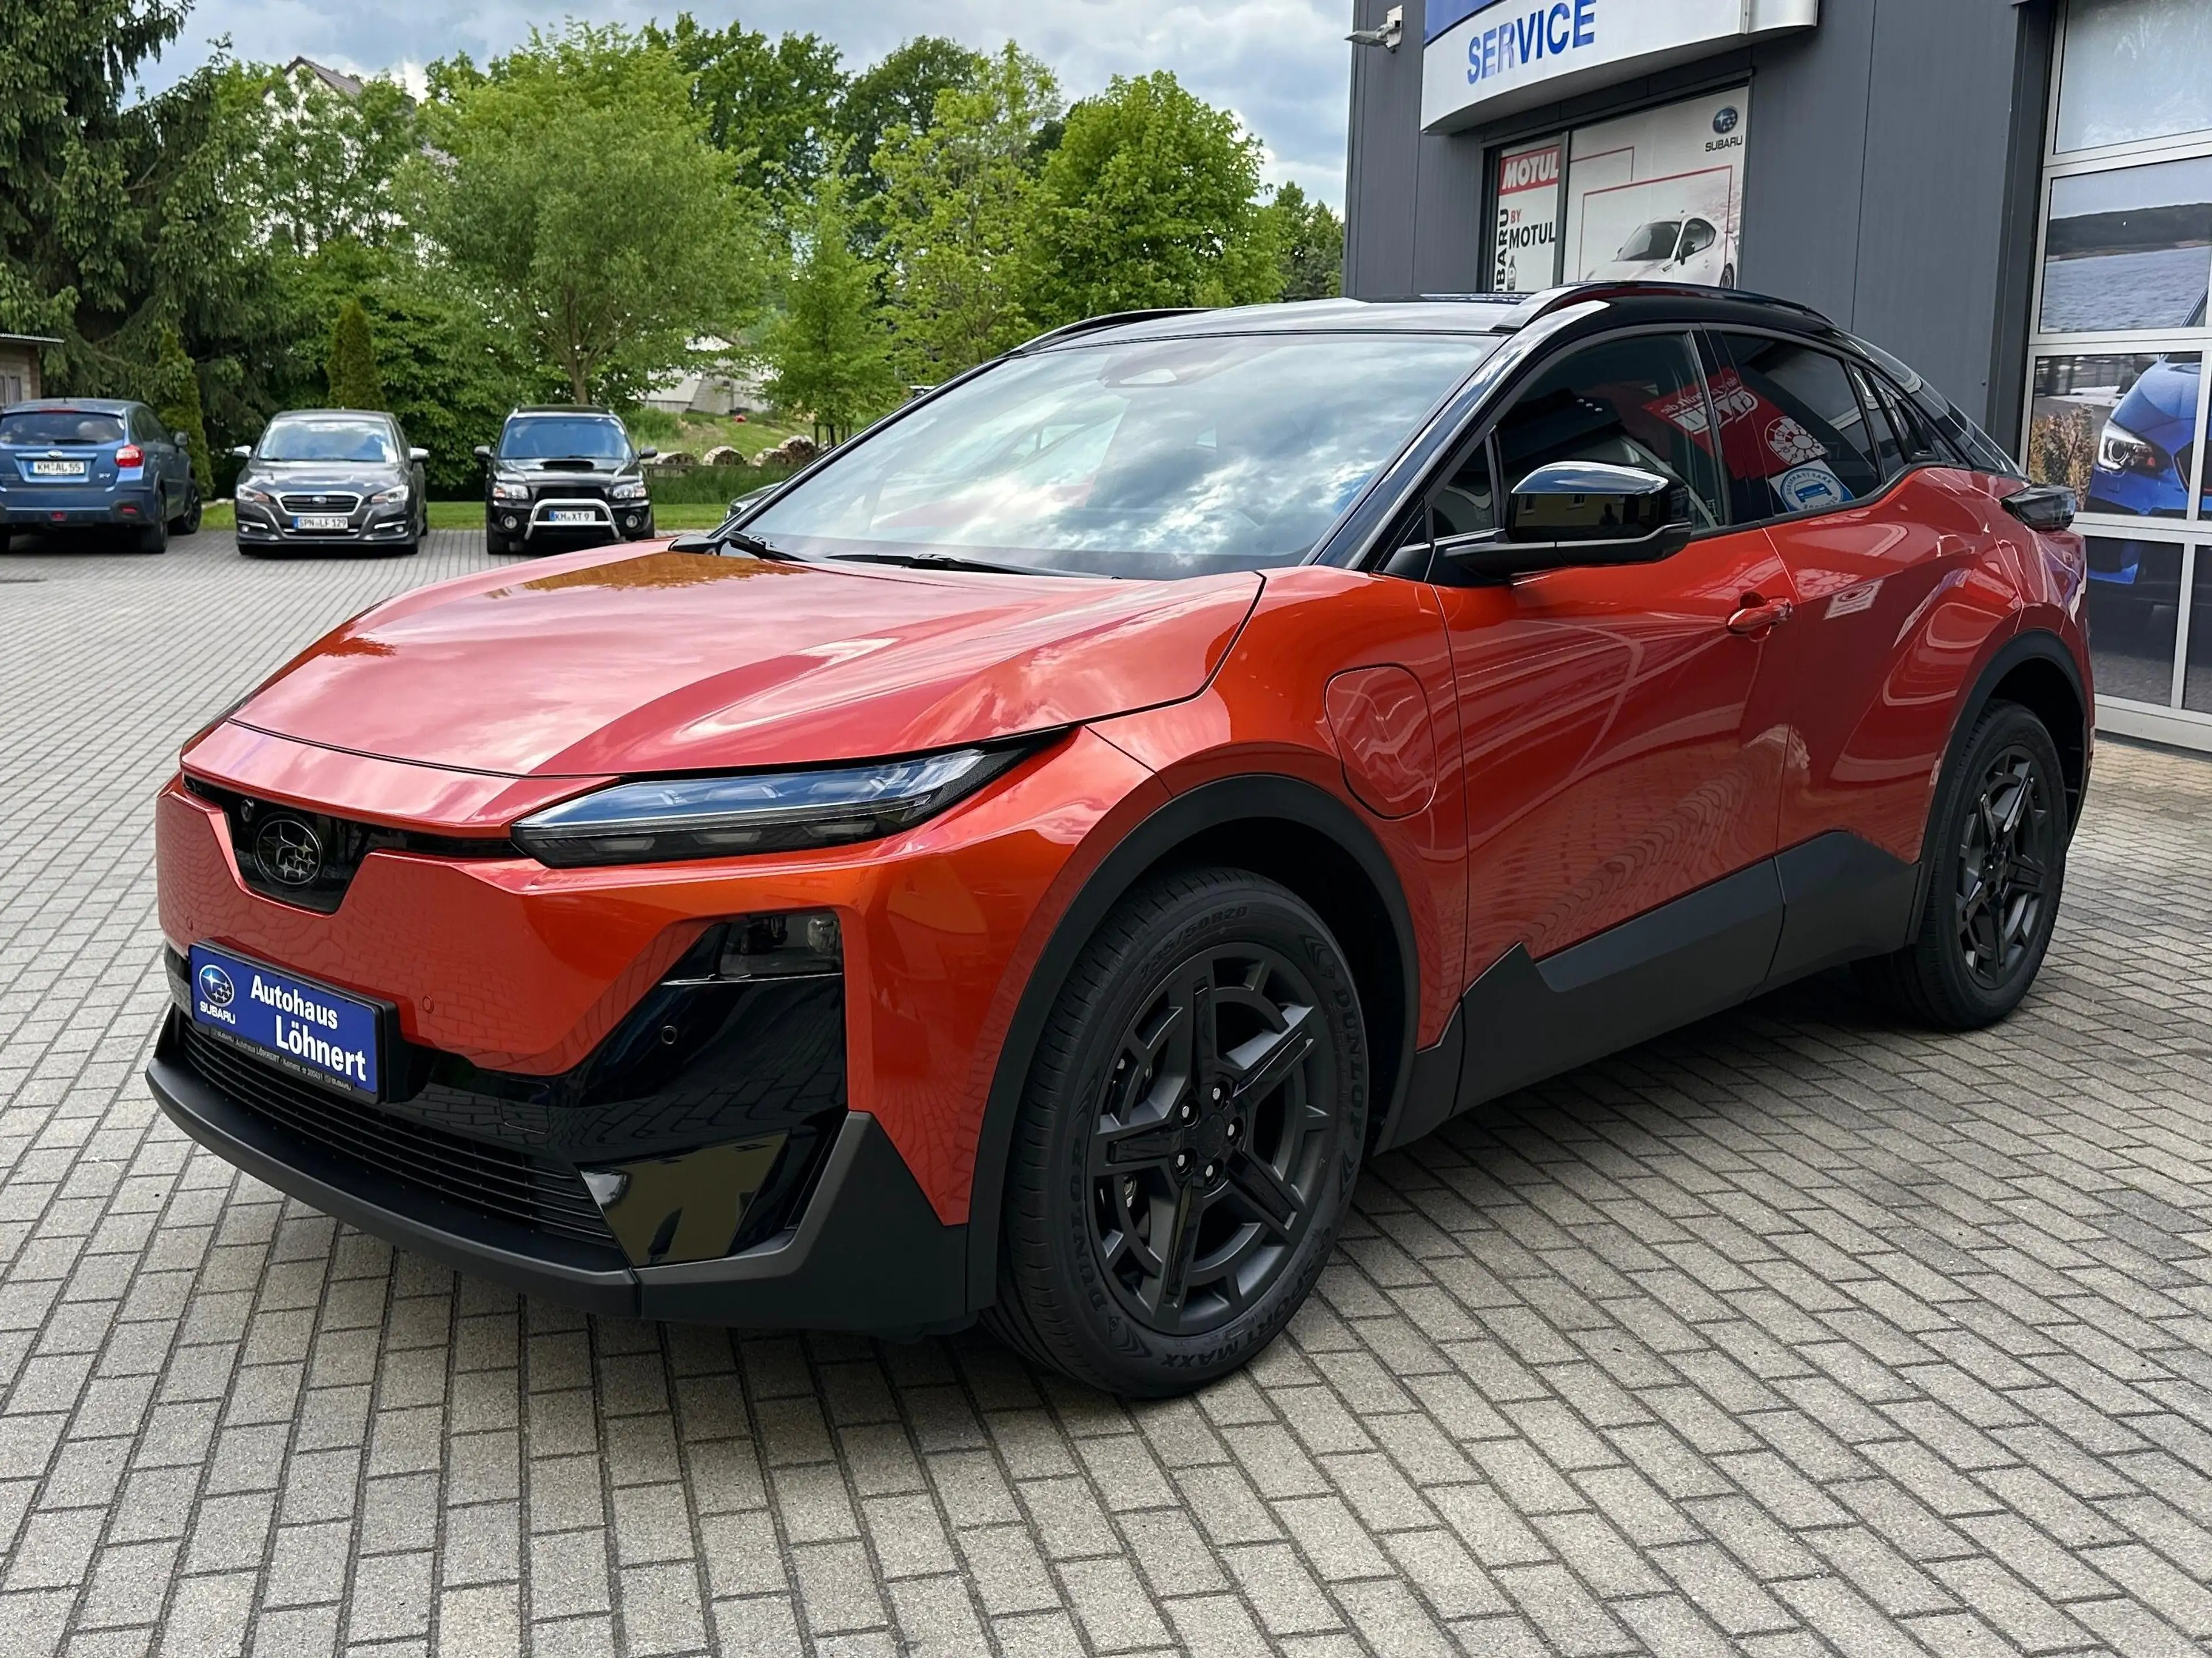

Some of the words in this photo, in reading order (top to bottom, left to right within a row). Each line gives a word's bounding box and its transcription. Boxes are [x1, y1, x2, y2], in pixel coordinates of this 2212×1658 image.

[1467, 0, 1596, 85] SERVICE
[1705, 135, 1743, 152] SUBARU
[1502, 151, 1558, 190] MOTUL
[1510, 208, 1522, 223] BY
[1496, 208, 1509, 291] BARU
[1509, 222, 1555, 249] MOTUL
[572, 513, 582, 521] XT
[200, 1001, 236, 1025] SUBARU
[250, 974, 338, 1030] Autohaus
[275, 1015, 366, 1082] Löhnert
[1334, 985, 1364, 1141] DUNLOP
[1070, 1136, 1108, 1312] DUNLOP
[1161, 1339, 1238, 1368] MAXX
